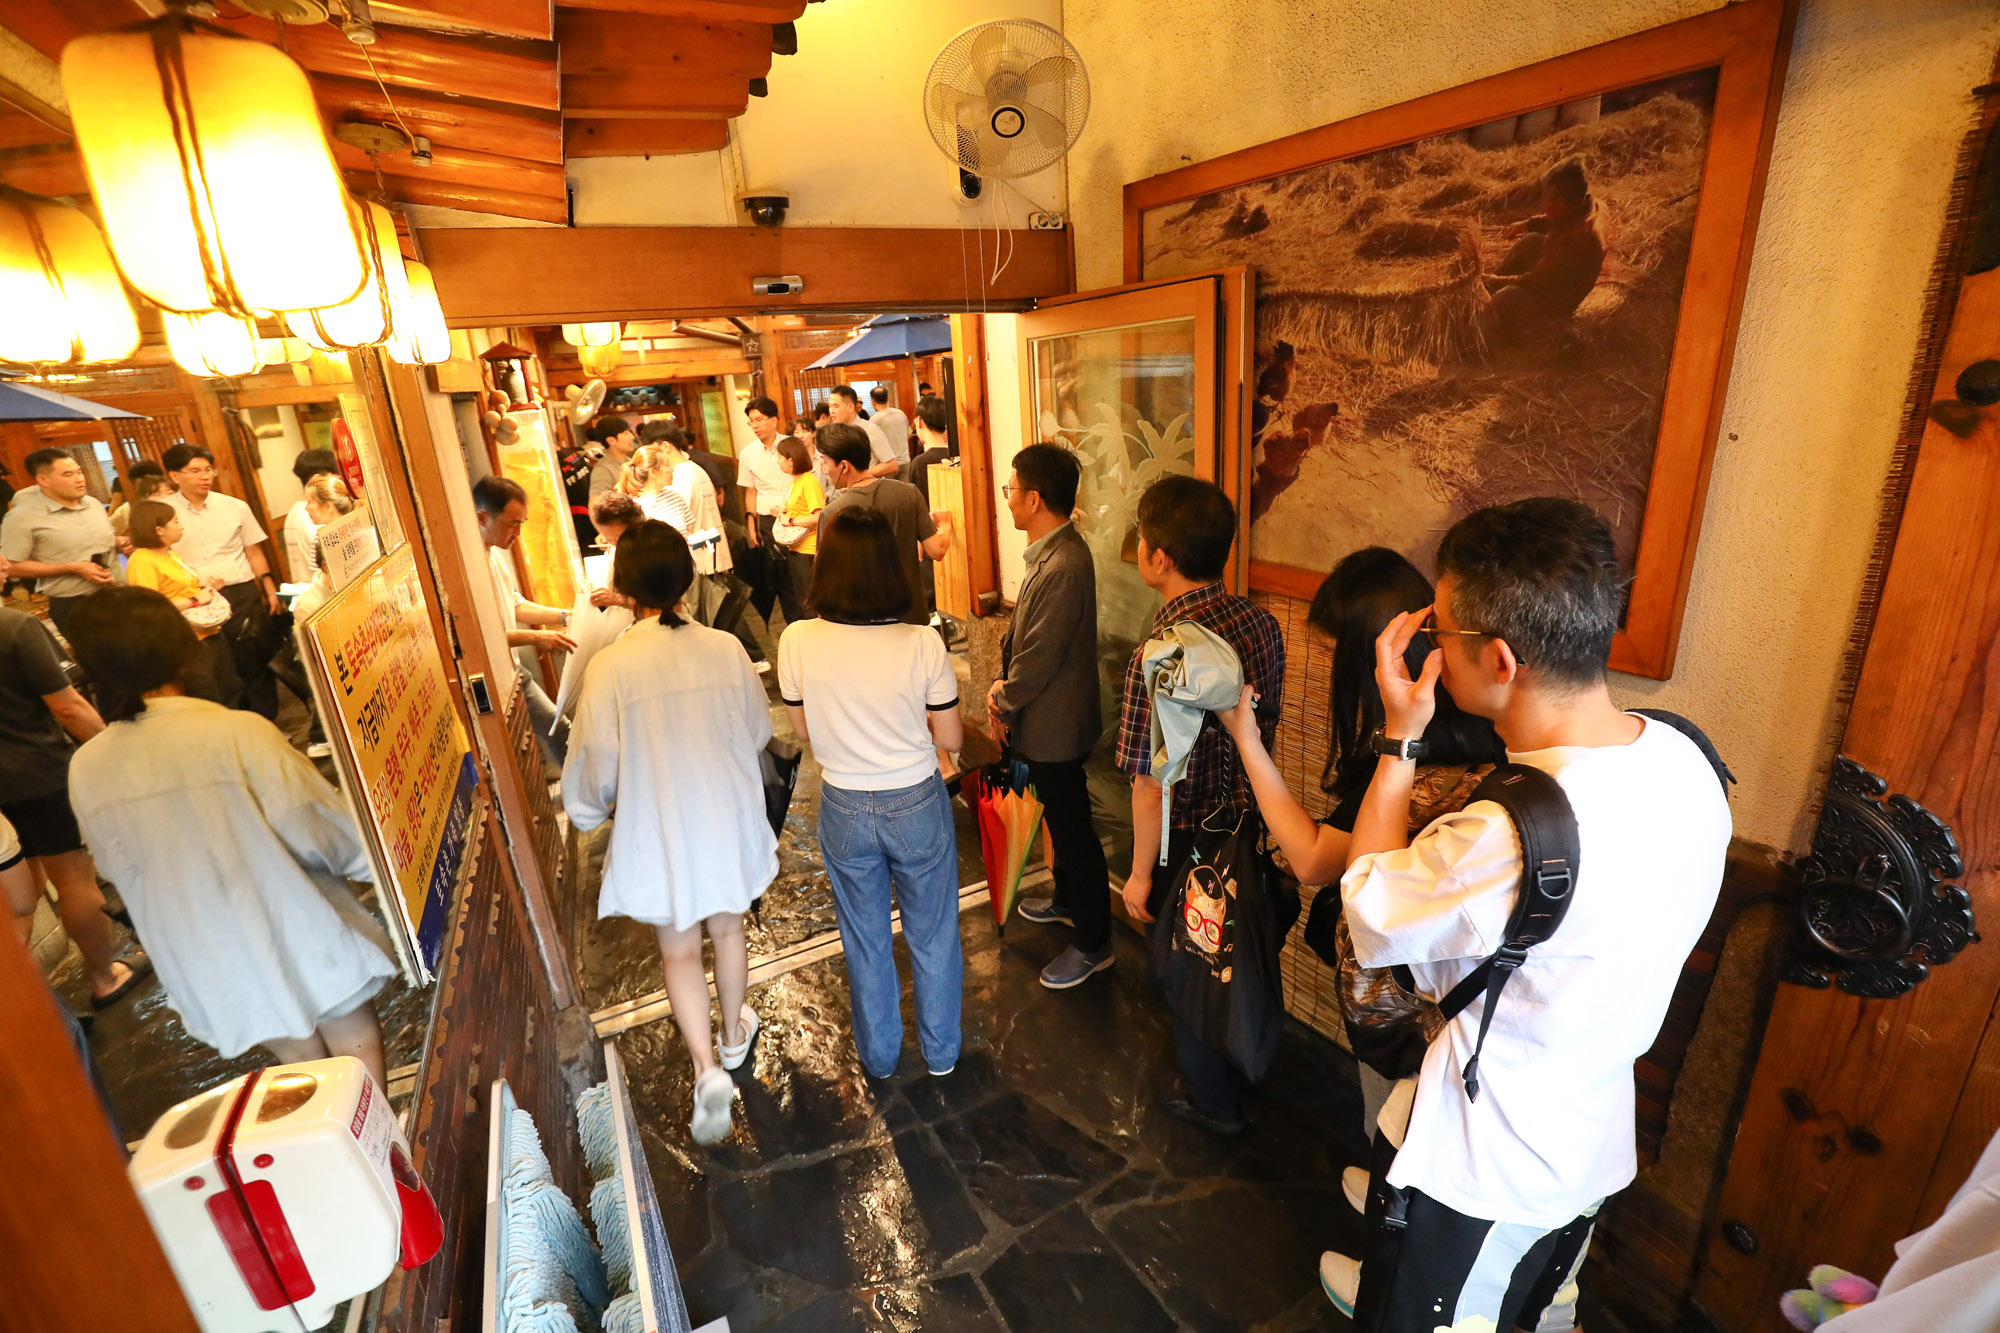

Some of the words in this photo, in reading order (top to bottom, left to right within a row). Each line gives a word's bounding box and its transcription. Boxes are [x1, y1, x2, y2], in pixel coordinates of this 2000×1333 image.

[334, 649, 353, 697] 본
[344, 603, 394, 680] 토속촌삼계탕은
[357, 681, 391, 753] 지금까지
[372, 769, 395, 827] 오징어
[385, 744, 406, 799] 은행,
[396, 720, 416, 769] 무우,
[393, 827, 416, 874] 마늘,
[405, 780, 426, 841] 생강은
[417, 738, 441, 799] 국내산만
[434, 848, 452, 907] 토속촌
[446, 819, 459, 857] 가족
